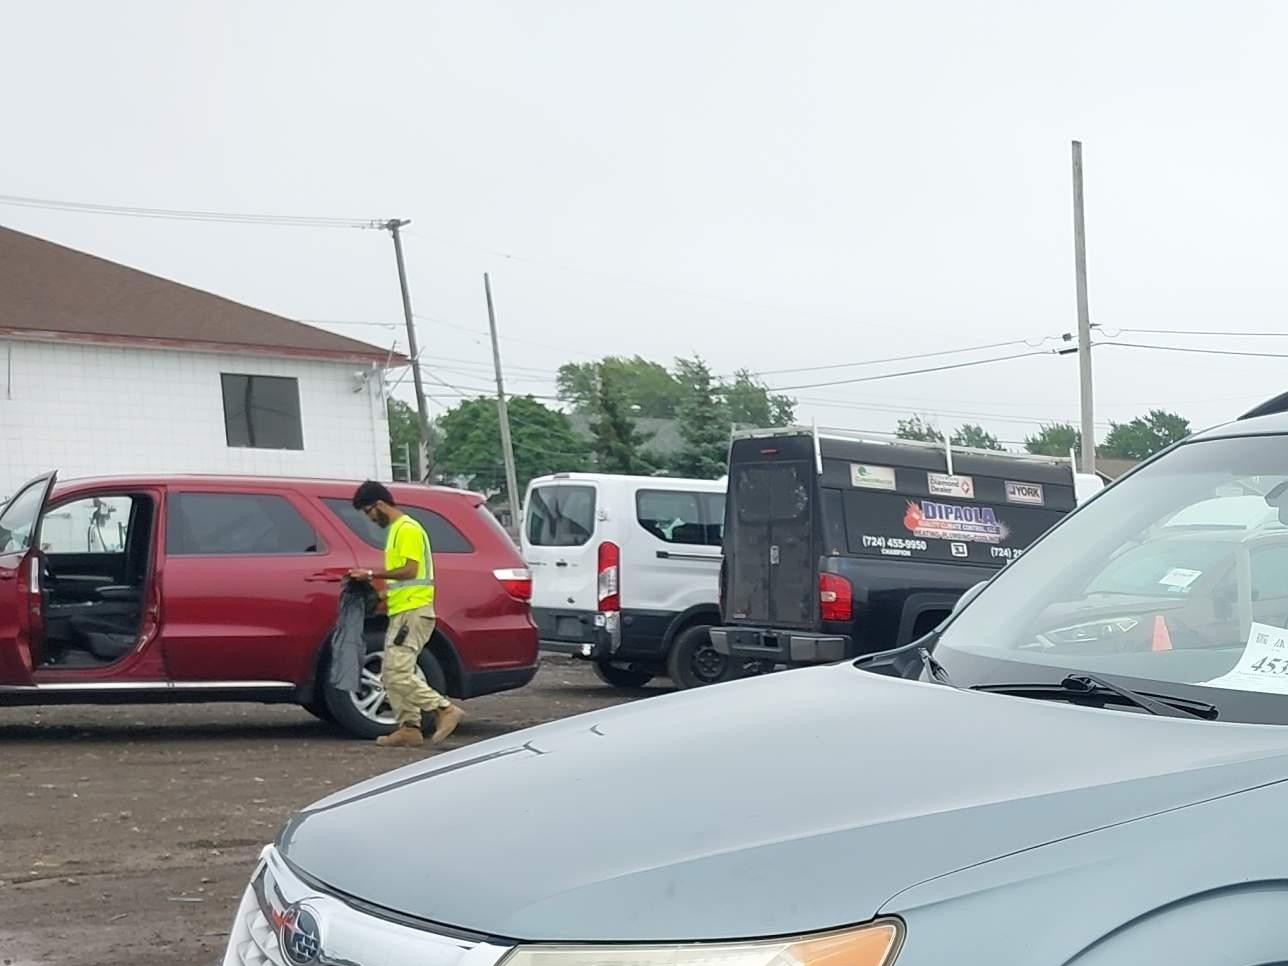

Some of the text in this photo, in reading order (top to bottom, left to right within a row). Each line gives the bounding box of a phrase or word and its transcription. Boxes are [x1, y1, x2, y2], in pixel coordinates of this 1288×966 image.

[930, 478, 960, 488] Diamond
[930, 485, 953, 494] Dealer
[1015, 486, 1041, 498] YORK
[921, 501, 997, 527] DIPAOLA
[862, 535, 886, 548] (724)
[990, 546, 1012, 559] (724)
